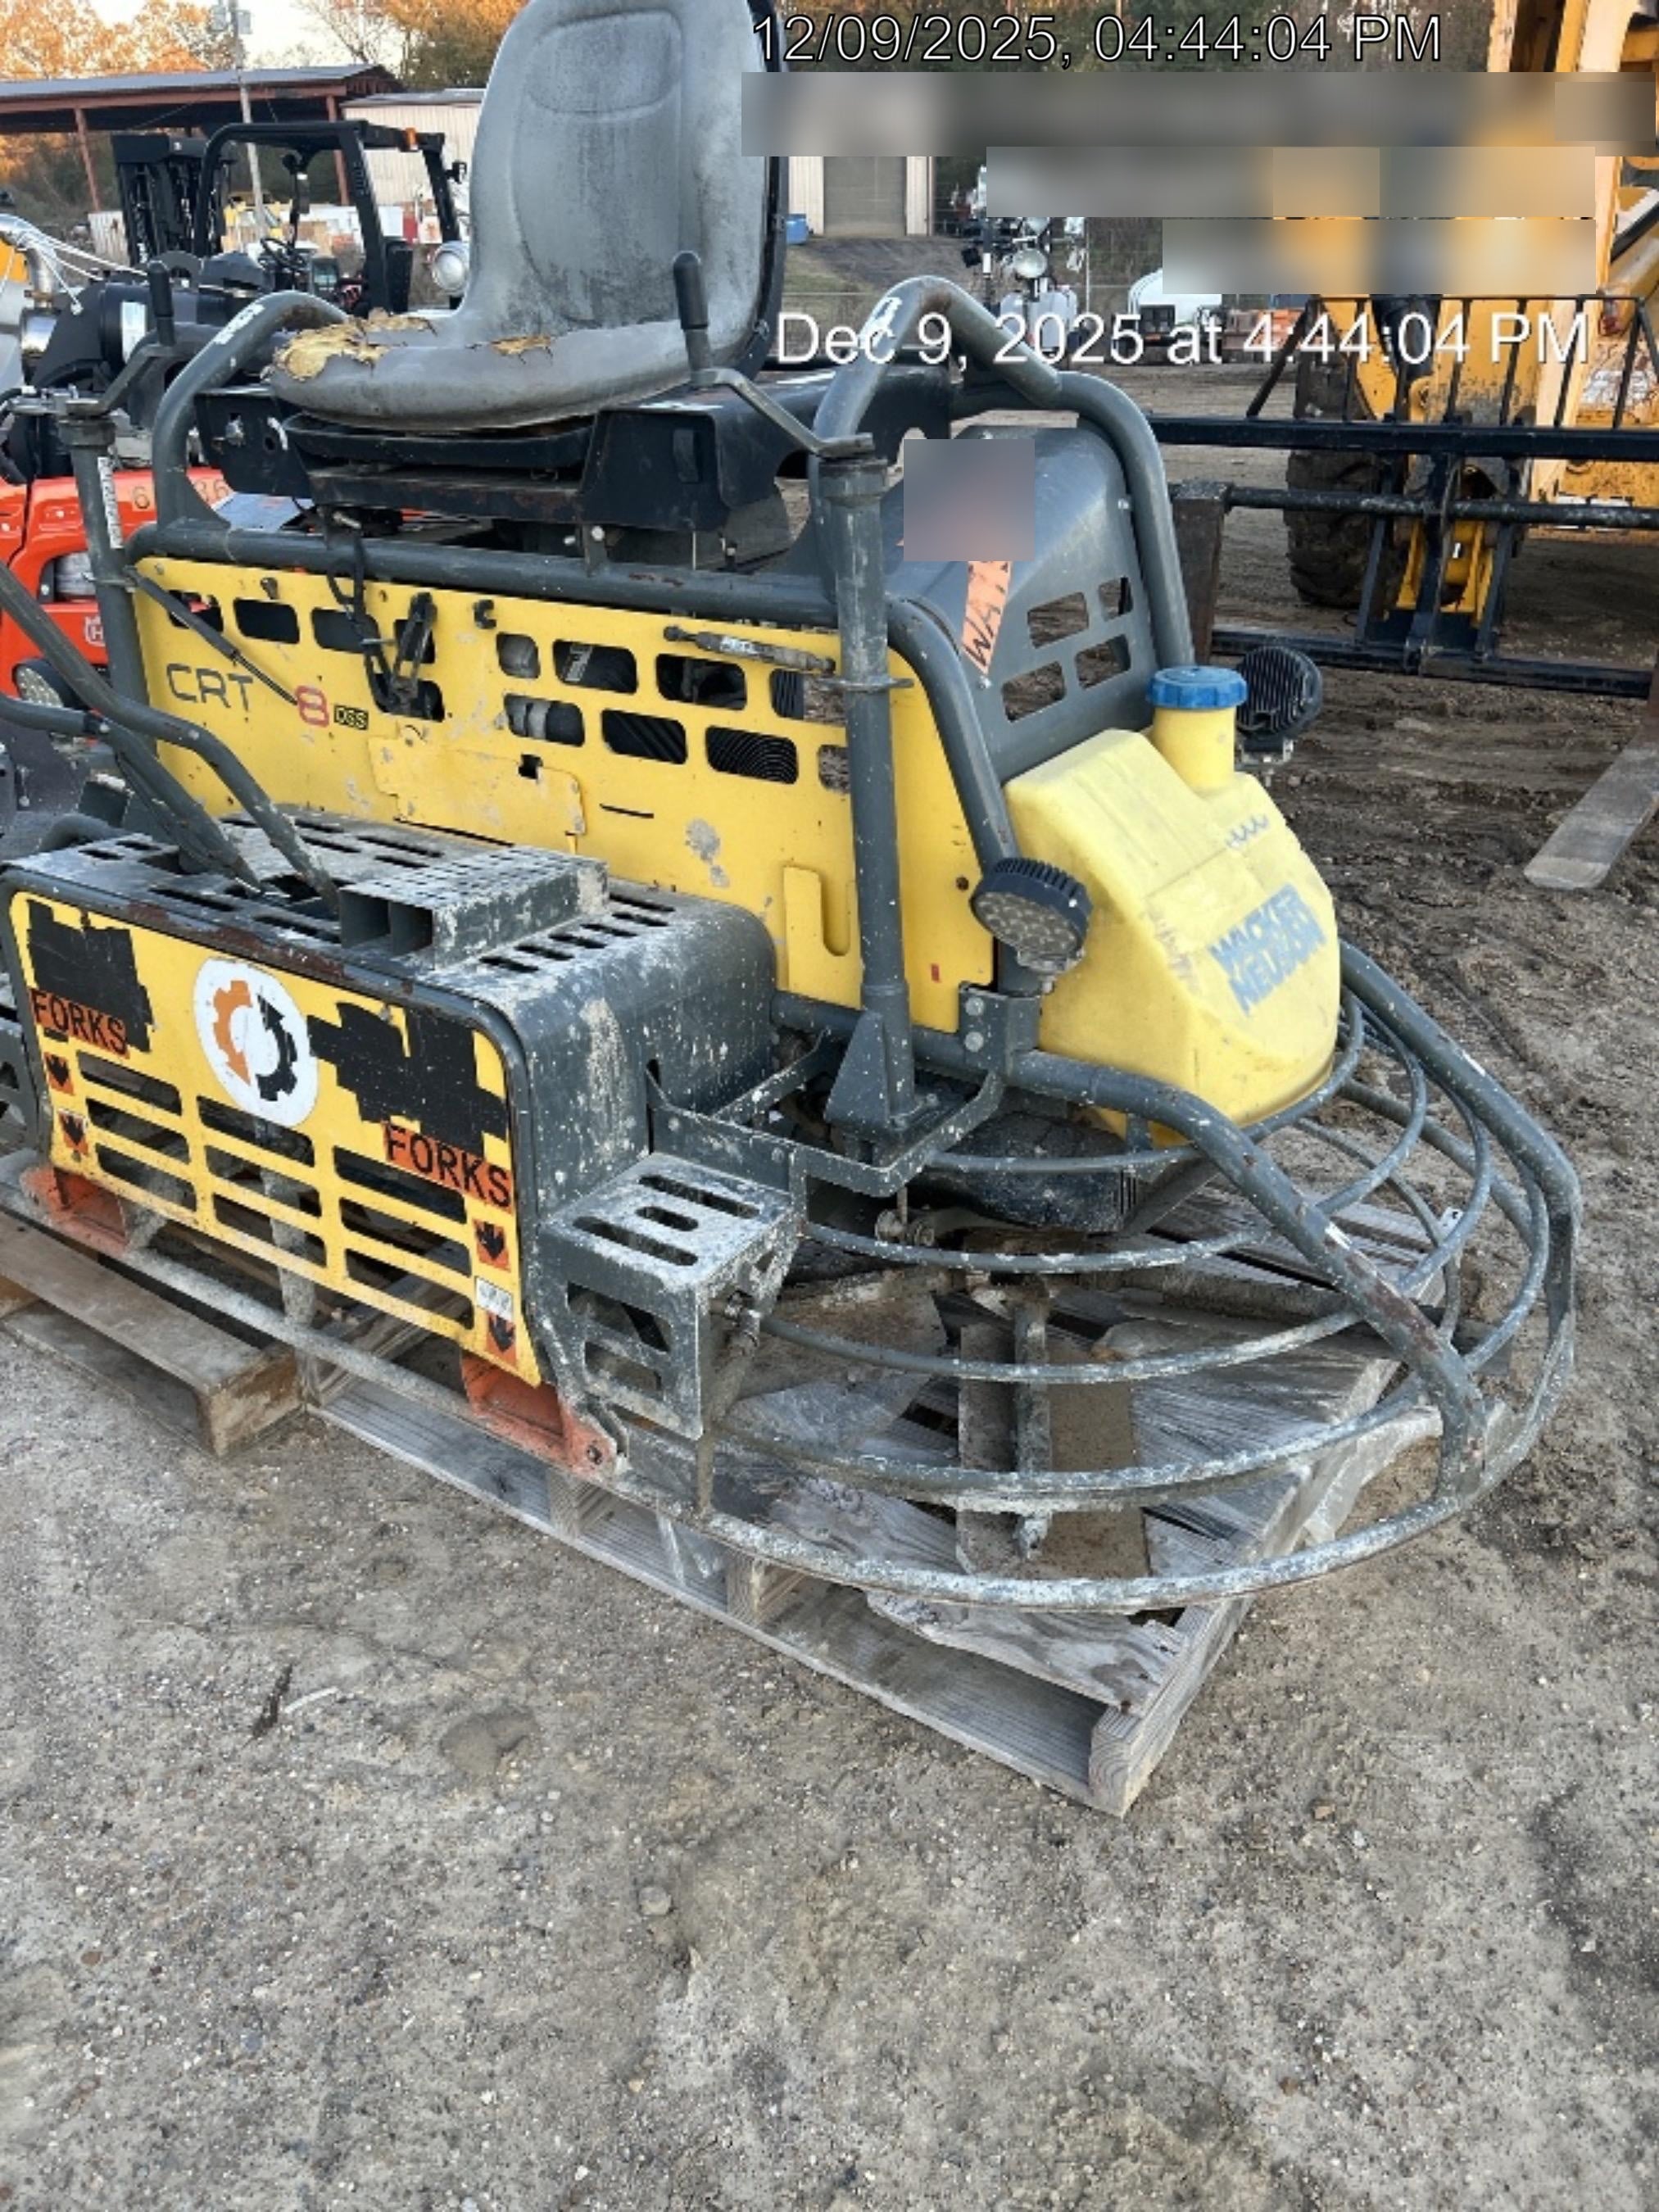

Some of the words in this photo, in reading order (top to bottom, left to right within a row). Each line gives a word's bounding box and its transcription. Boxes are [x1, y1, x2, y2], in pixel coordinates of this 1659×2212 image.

[166, 663, 253, 712] CRT
[295, 685, 329, 728] 8
[30, 988, 129, 1055] FORKS
[387, 1124, 511, 1208] FORKS
